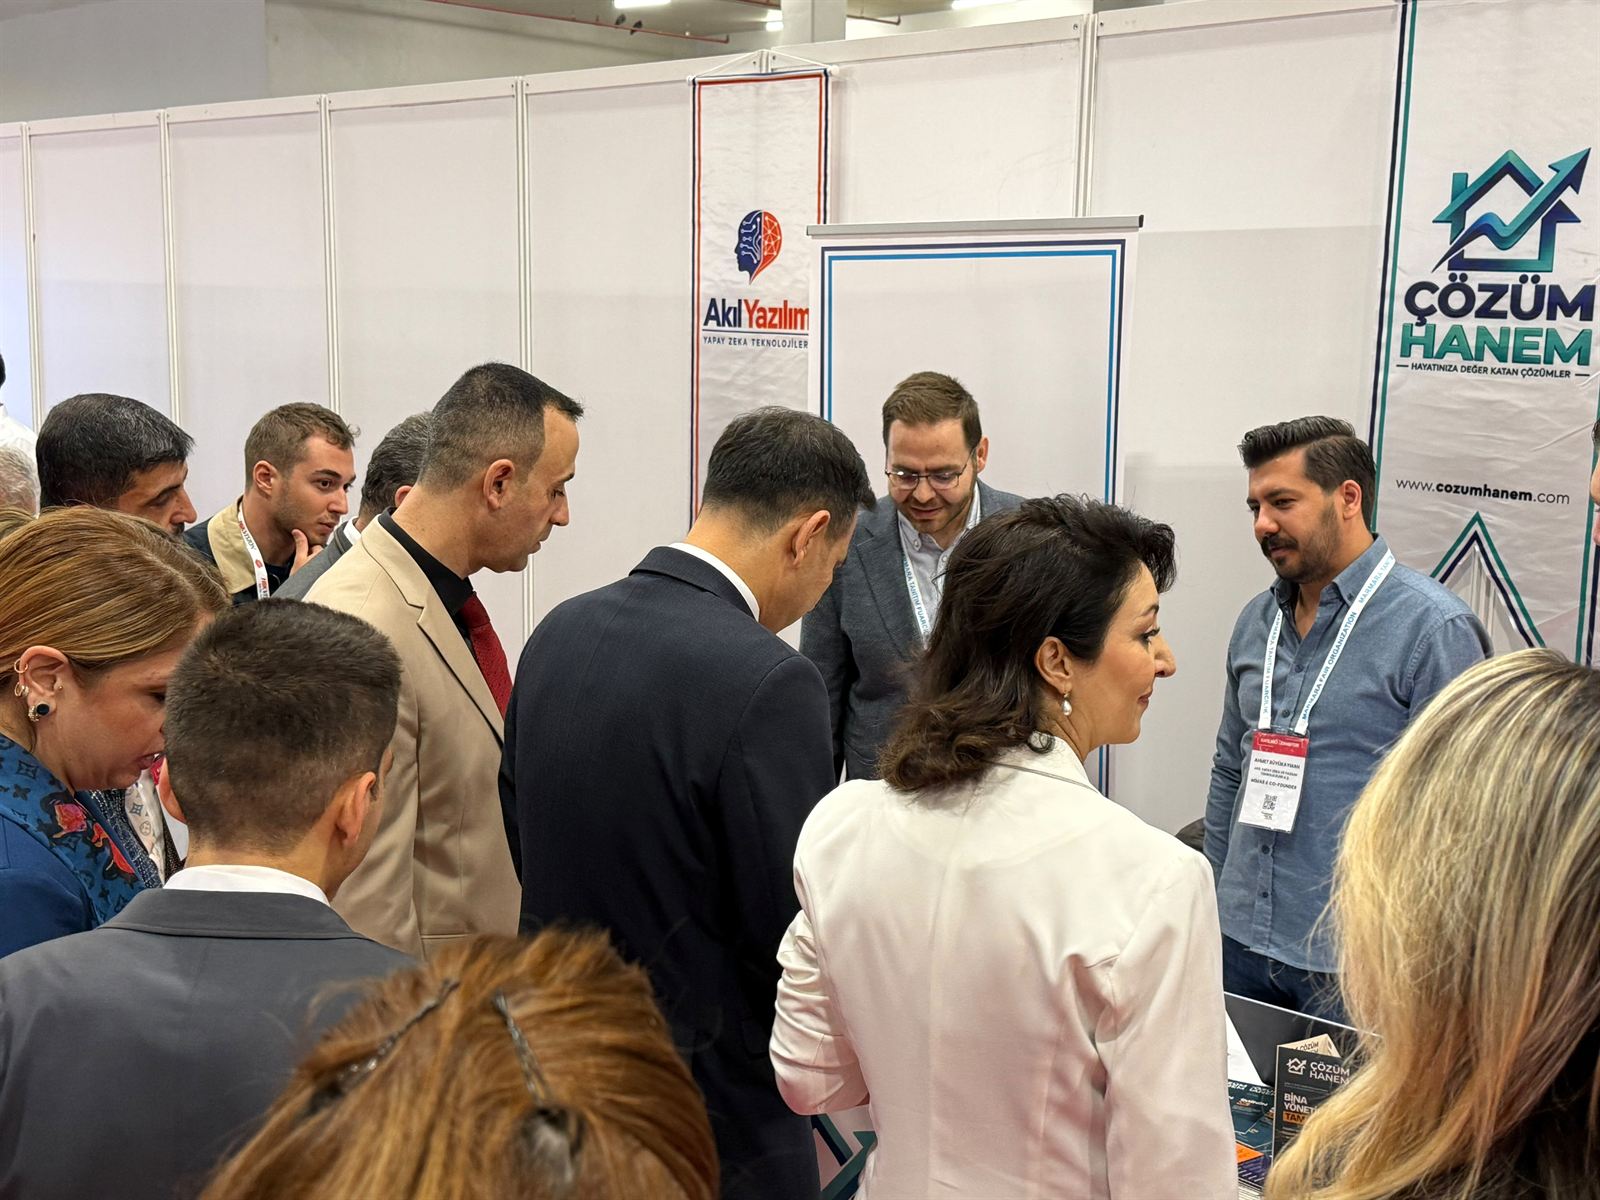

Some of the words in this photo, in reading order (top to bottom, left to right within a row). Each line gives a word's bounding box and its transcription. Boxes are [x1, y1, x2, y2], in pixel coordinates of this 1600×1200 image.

[1404, 272, 1596, 327] ÇÖZÜM
[703, 297, 742, 328] Akıl
[743, 298, 809, 330] Yazılım
[703, 336, 725, 345] YAPAY
[728, 337, 748, 346] ZEKA
[1400, 323, 1593, 366] HANEM
[1411, 362, 1458, 373] HAYATINIZA
[1460, 364, 1489, 375] DEĞER
[1490, 367, 1519, 376] KATAN
[1521, 367, 1571, 378] ÇÖZÜMLER
[1396, 479, 1570, 505] www.cozumhanem.com
[1302, 678, 1322, 720] MARMARA
[1319, 664, 1331, 683] FAIR
[1328, 611, 1357, 665] ORGANIZATION
[1310, 1061, 1350, 1077] ÇÖZÜM
[1310, 1070, 1350, 1085] HANEM
[1284, 1092, 1307, 1105] BİNA
